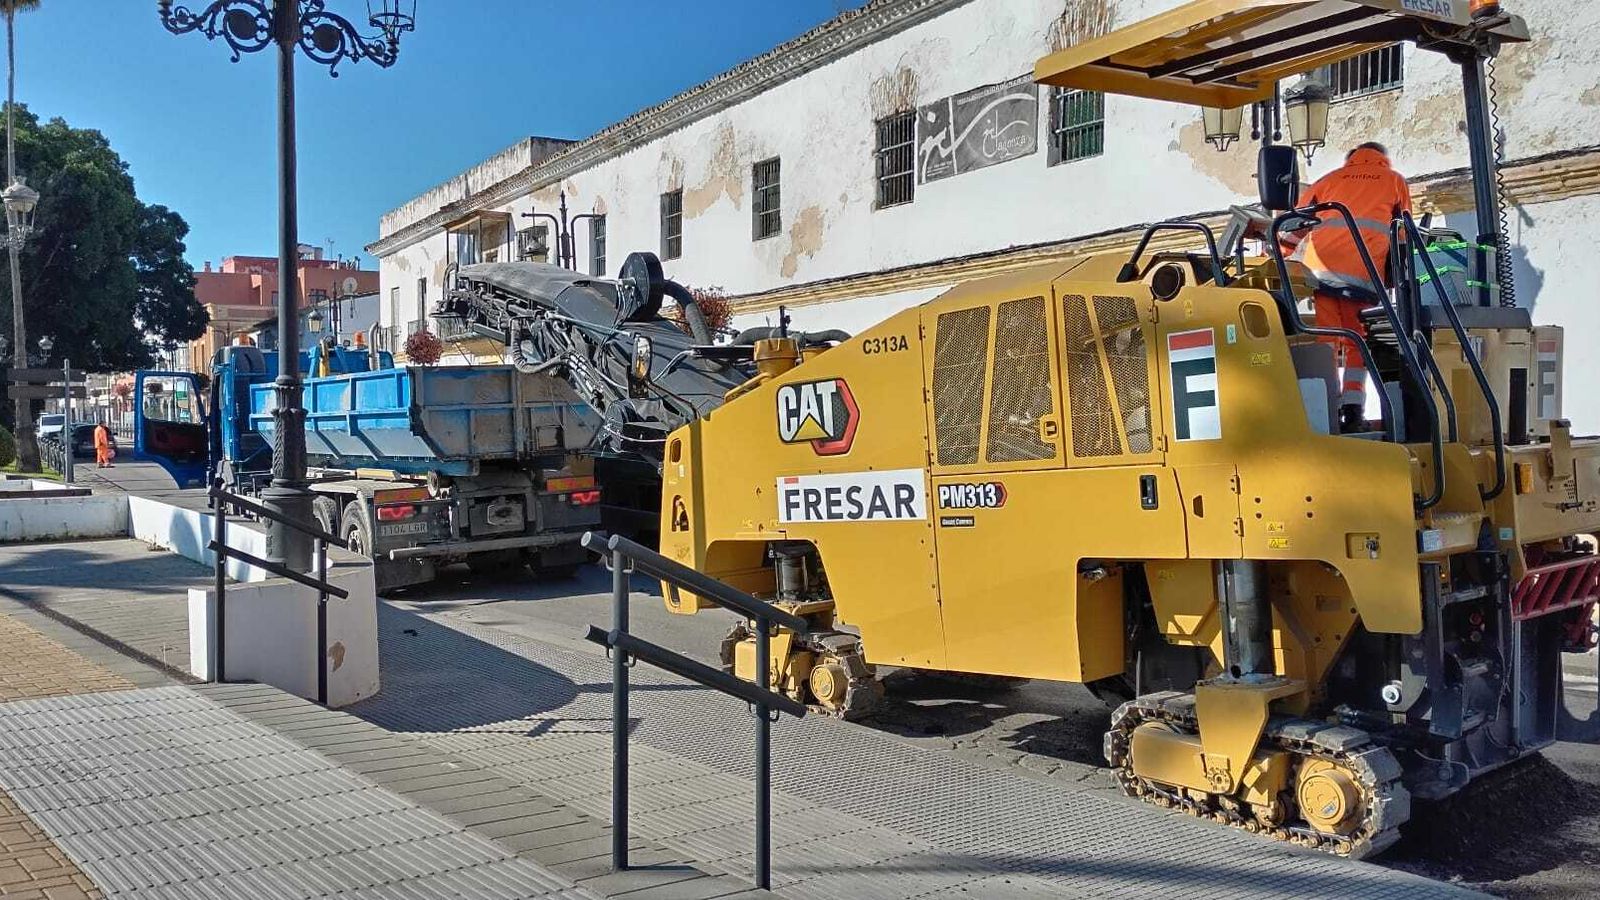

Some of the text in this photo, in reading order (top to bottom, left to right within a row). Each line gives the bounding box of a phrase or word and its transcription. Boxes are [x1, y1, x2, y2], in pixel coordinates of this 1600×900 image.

[1404, 0, 1451, 16] FRESAR
[863, 336, 908, 354] C313A
[777, 380, 837, 442] CAT
[1171, 357, 1217, 440] F
[784, 483, 918, 521] FRESAR
[938, 482, 998, 509] PM313
